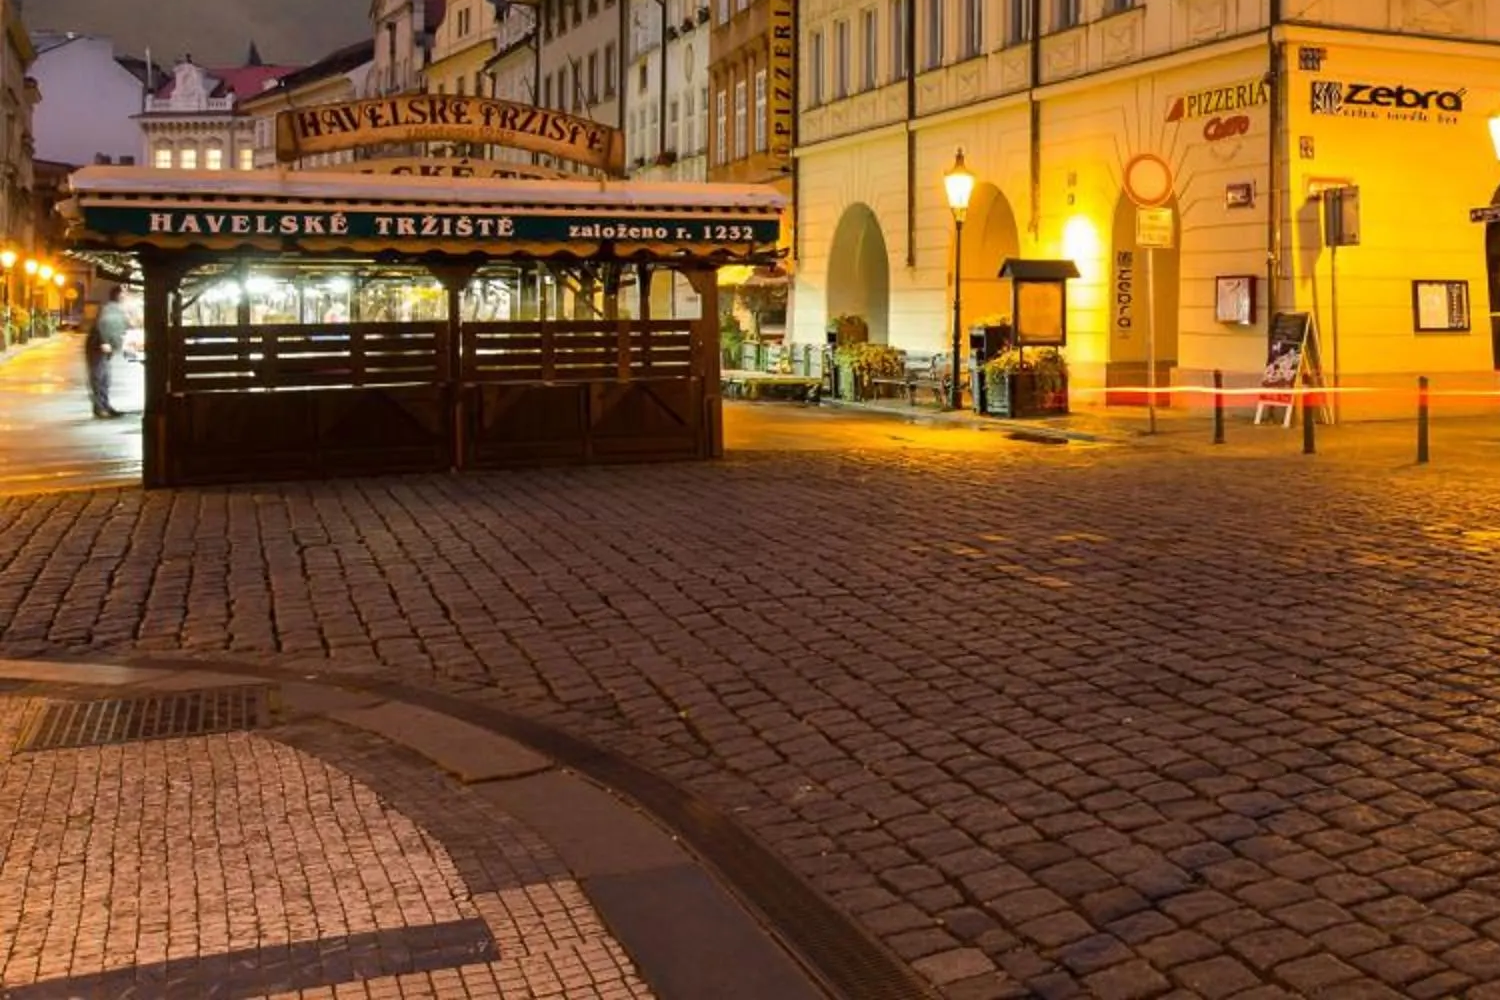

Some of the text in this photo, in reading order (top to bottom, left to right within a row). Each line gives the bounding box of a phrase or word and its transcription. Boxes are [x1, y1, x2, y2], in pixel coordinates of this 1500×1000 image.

[1187, 80, 1268, 118] PIZZERIA
[1344, 83, 1465, 112] zebra
[149, 210, 350, 235] HAVELSKÉ
[569, 222, 668, 239] založeno
[675, 226, 692, 239] r.
[703, 225, 753, 240] 1232
